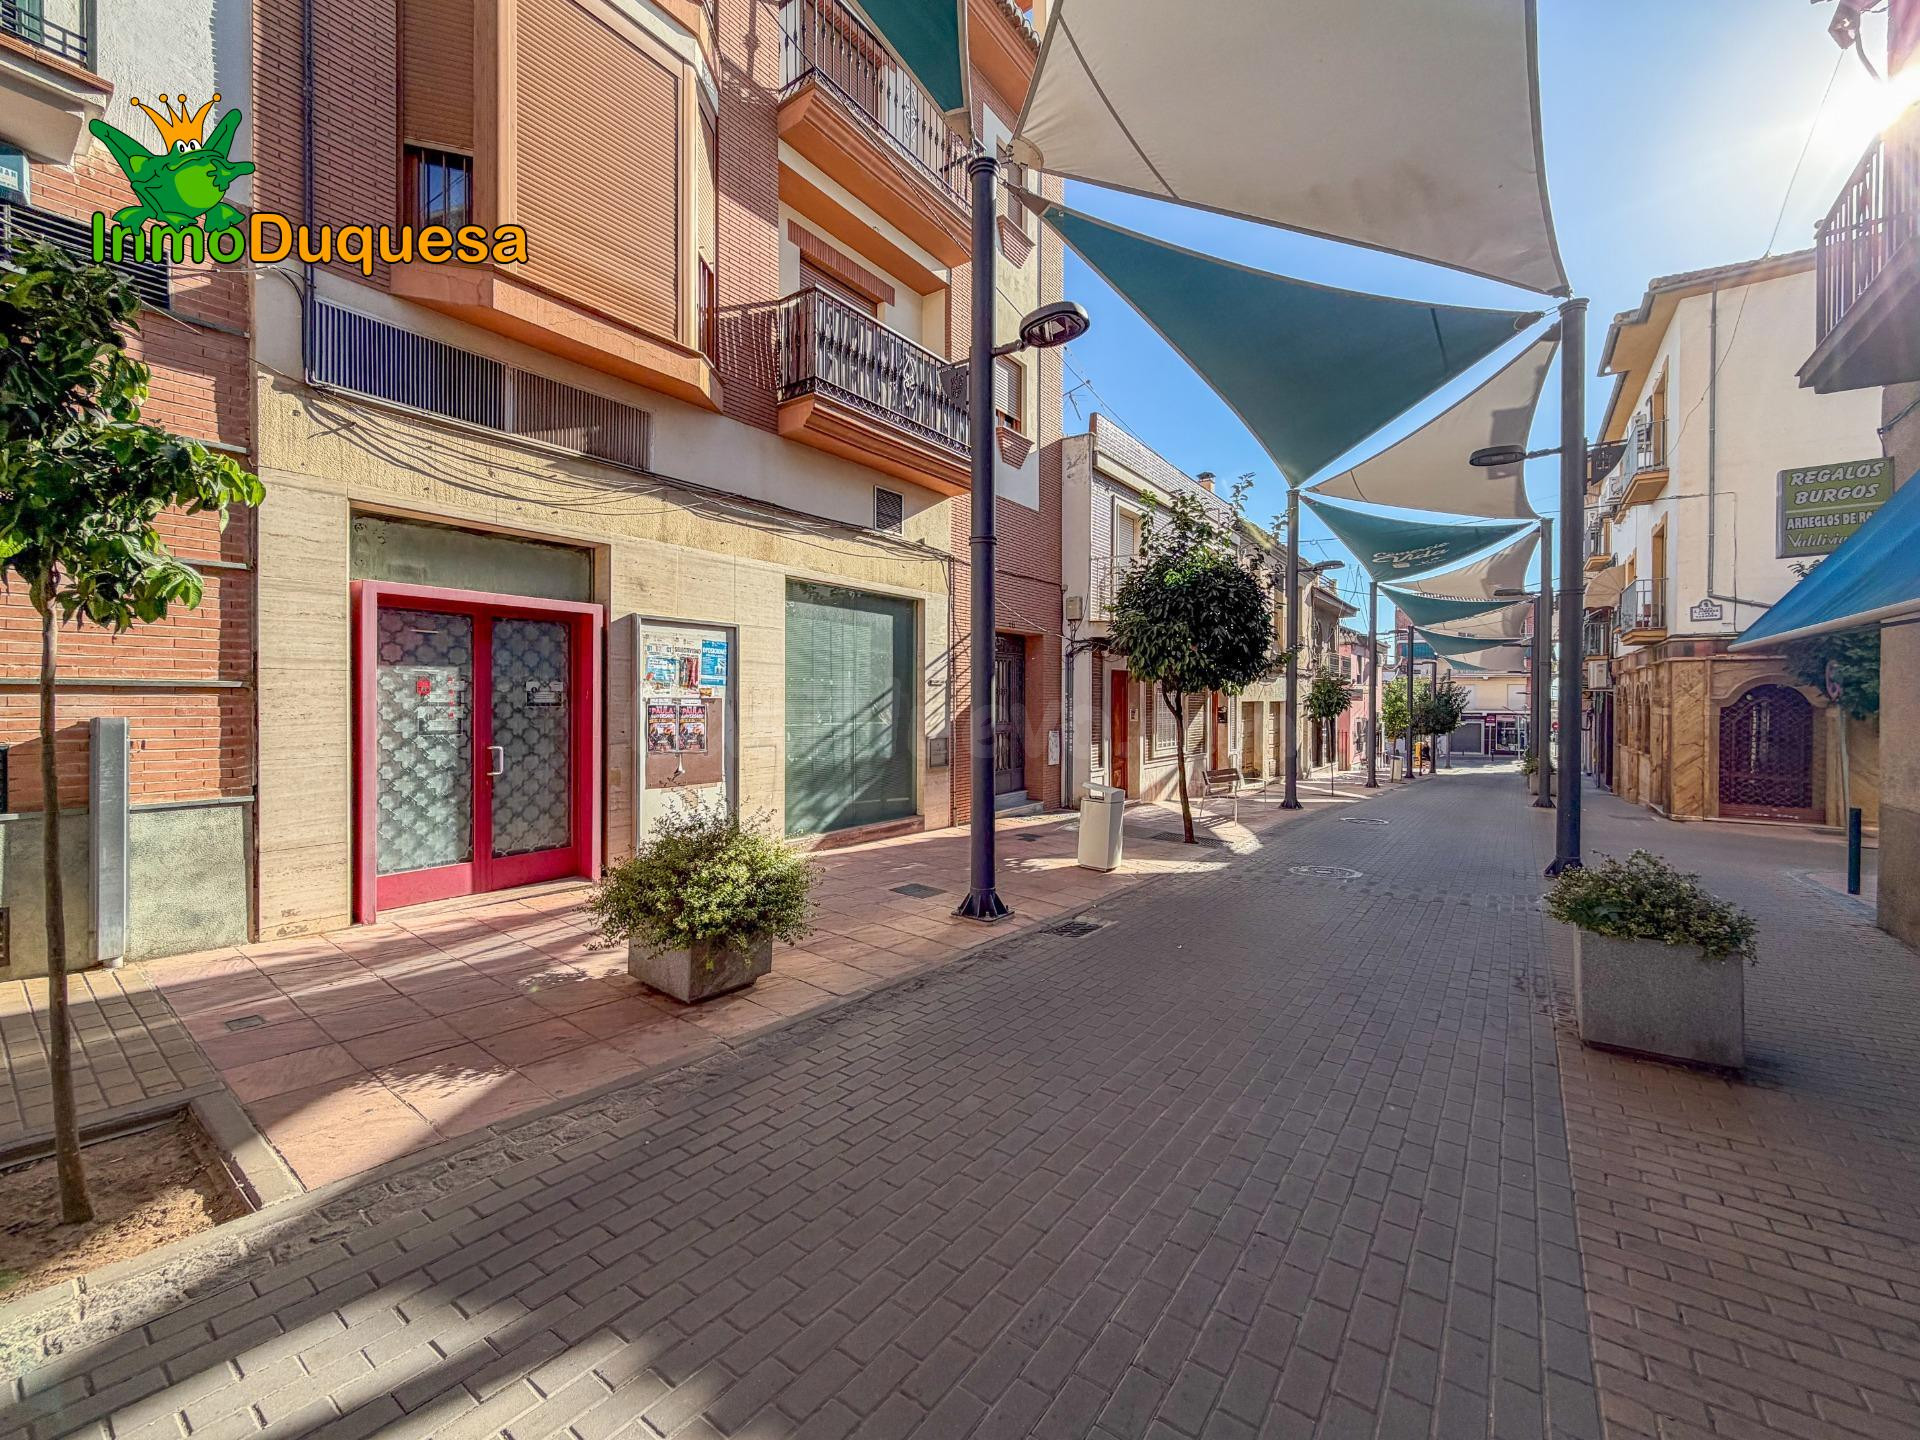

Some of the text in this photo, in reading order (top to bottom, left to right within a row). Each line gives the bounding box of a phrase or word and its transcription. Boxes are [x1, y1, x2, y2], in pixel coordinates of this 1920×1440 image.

[1790, 462, 1885, 486] REGALOS
[1794, 483, 1880, 504] BURGOS
[1786, 513, 1840, 530] ARREGLOS
[1842, 512, 1857, 525] DE
